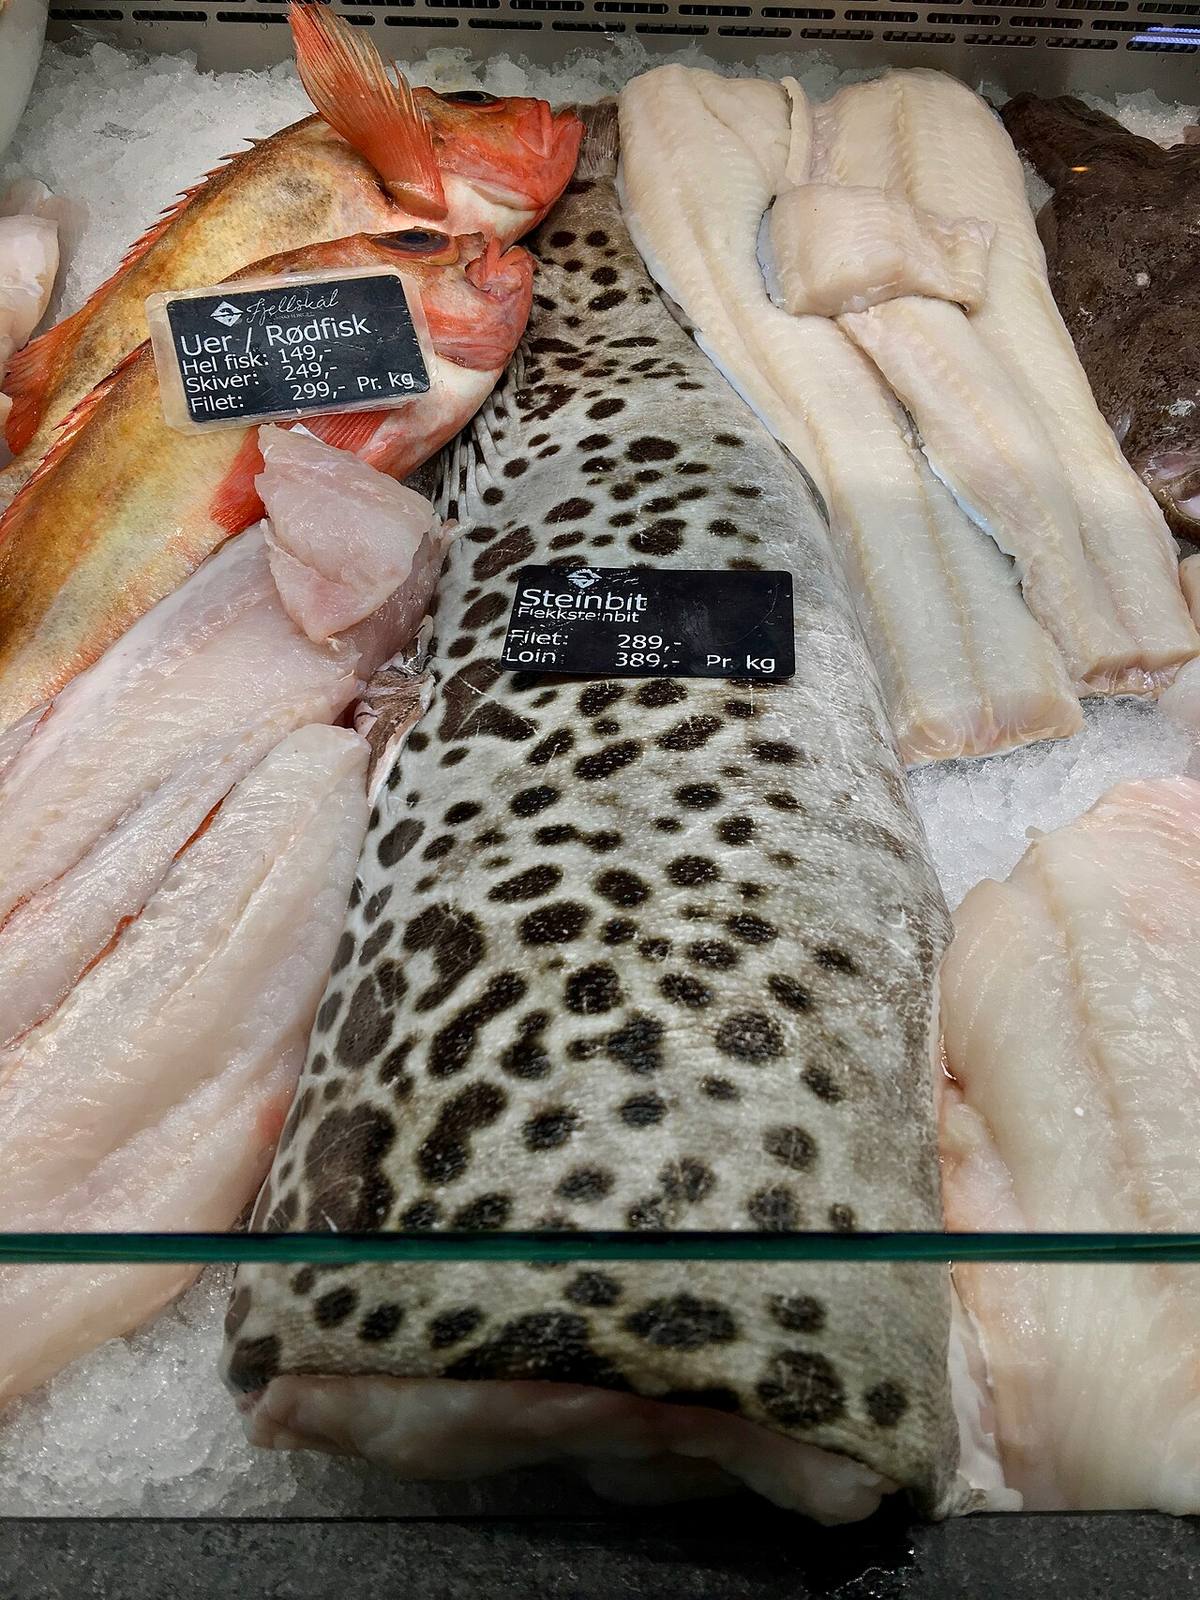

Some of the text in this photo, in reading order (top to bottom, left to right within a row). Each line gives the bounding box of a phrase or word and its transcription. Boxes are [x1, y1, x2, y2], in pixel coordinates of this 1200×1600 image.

[180, 333, 232, 356] Uer
[245, 327, 252, 353] /
[266, 314, 372, 346] Rødfisk
[182, 344, 332, 375] Hel fisk: 149,-
[186, 362, 338, 393] Skiver: 249,-
[190, 371, 415, 413] Filet: 299,- Pr. kg
[520, 588, 648, 612] Steinbit
[508, 629, 682, 652] Filet: 289,-
[614, 652, 680, 670] 389,-
[746, 654, 776, 673] kg
